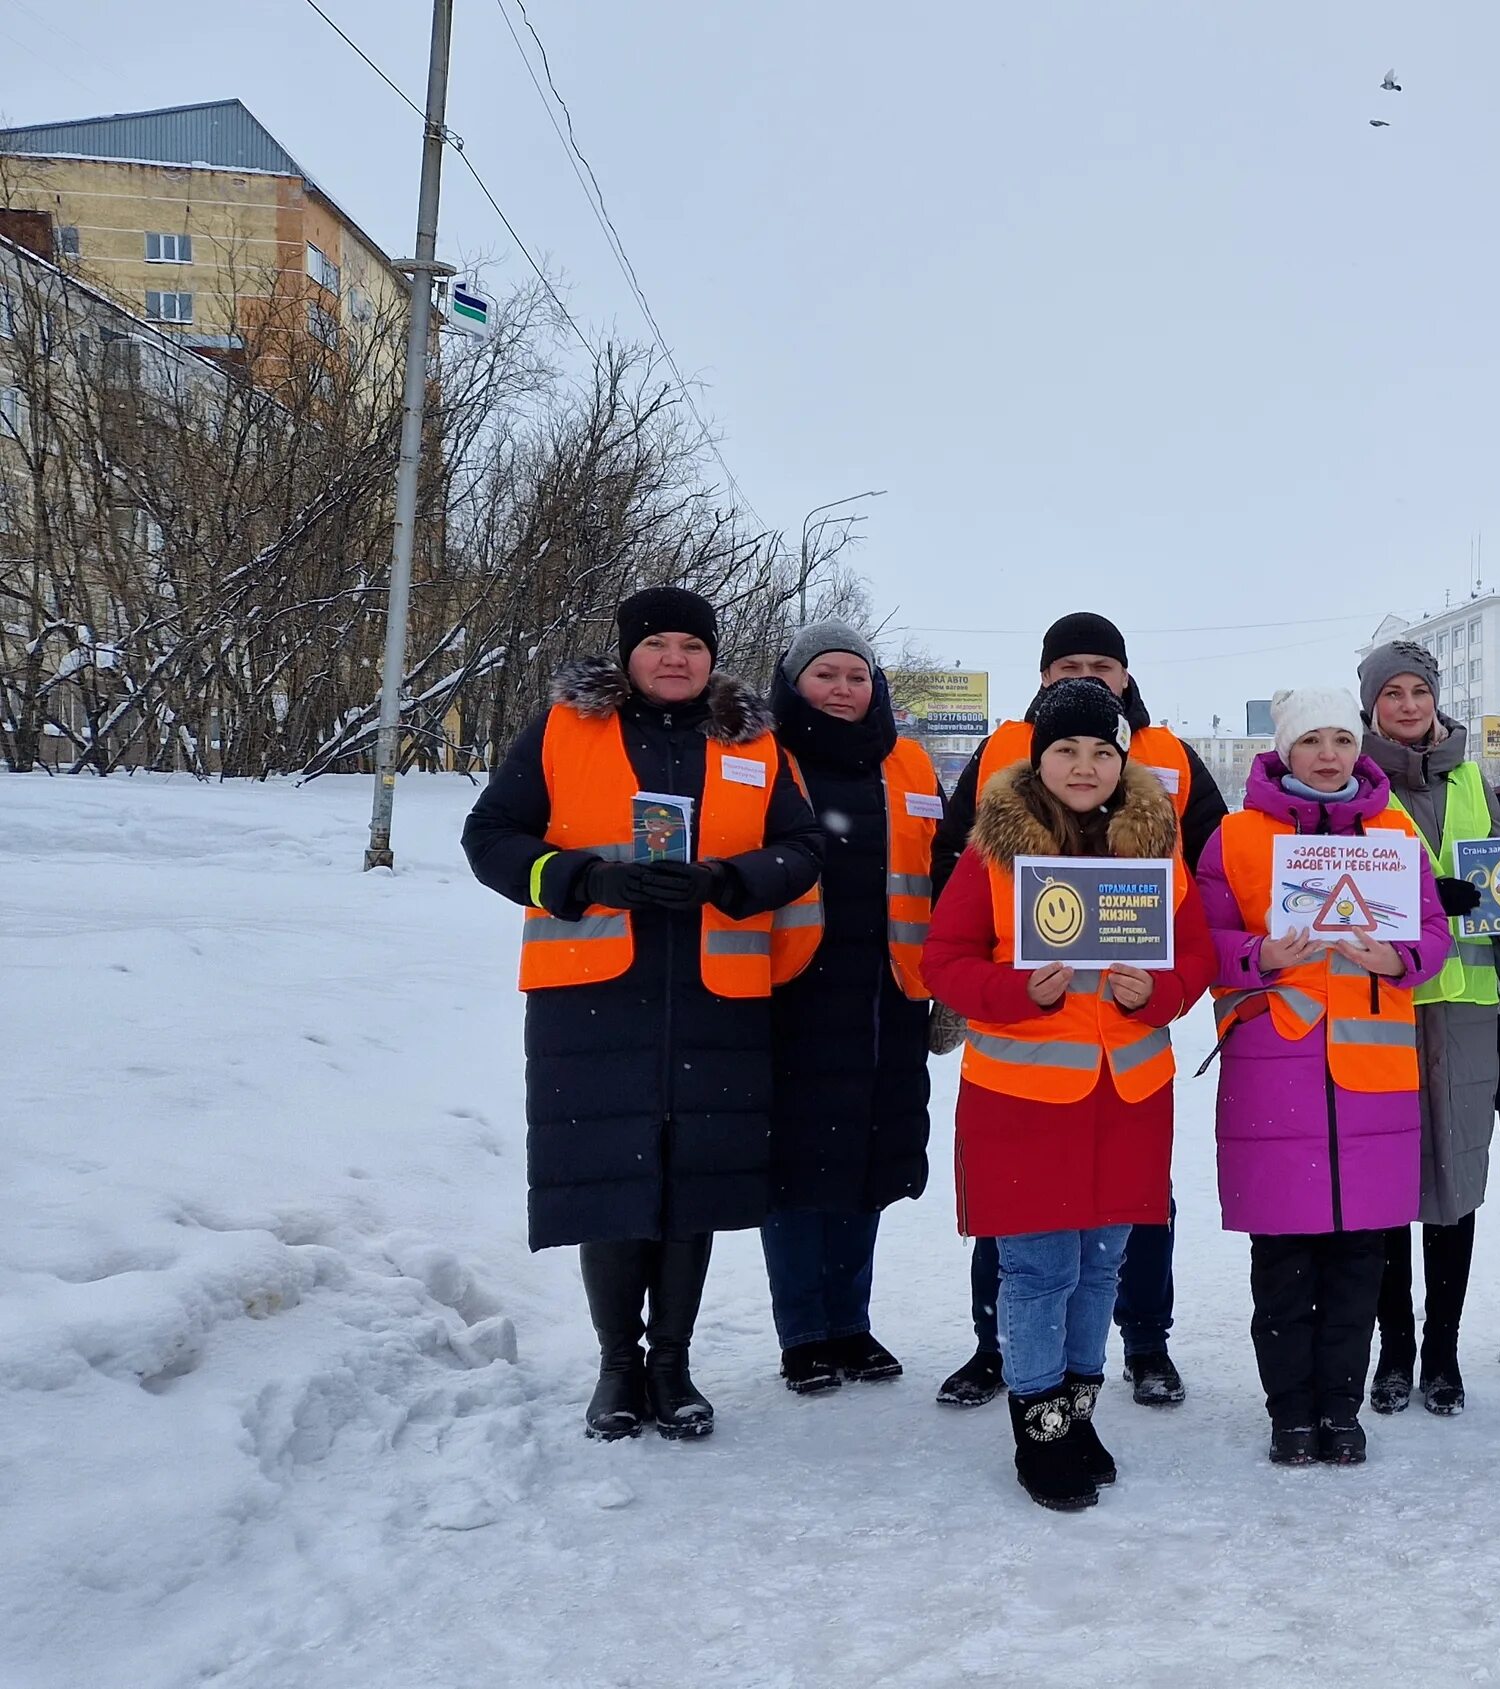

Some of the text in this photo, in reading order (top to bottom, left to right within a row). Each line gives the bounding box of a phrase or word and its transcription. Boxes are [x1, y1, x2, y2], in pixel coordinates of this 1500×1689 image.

[947, 676, 968, 684] АВТО
[927, 713, 983, 721] 89121766000
[1372, 847, 1400, 860] САМ,
[1463, 846, 1487, 855] Стань
[1286, 859, 1407, 872] ЗАСВЕТИ РЕБЕНКА!»
[1099, 884, 1160, 894] ОТРАЖАЯ СВЕТ,
[1099, 895, 1159, 907] СОХРАНЯЕТ
[1099, 909, 1137, 921] ЖИЗНЬ
